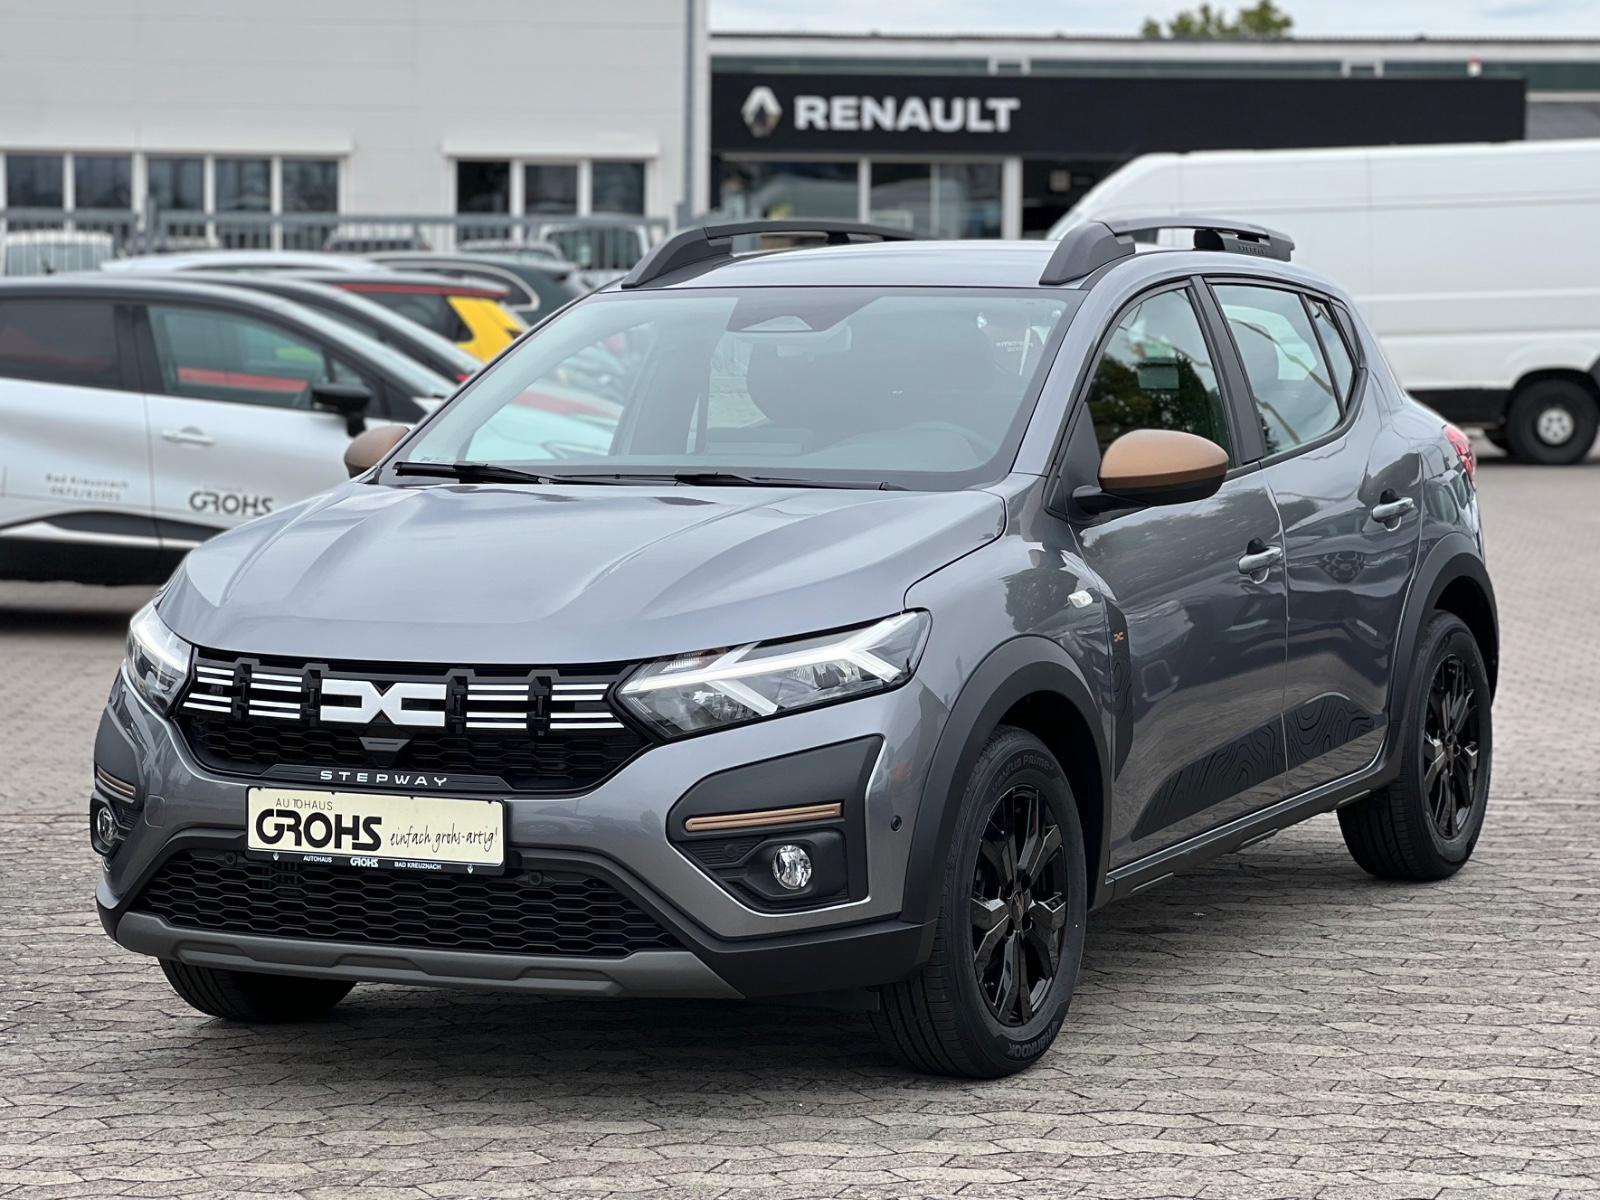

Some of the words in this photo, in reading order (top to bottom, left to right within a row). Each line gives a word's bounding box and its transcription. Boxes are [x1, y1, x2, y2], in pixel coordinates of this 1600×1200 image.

[794, 95, 1020, 132] RENAULT
[189, 490, 273, 517] GROHS
[320, 770, 447, 787] STEPWAY
[275, 798, 333, 811] AUTOHAUS
[255, 808, 382, 852] GROHS
[390, 824, 431, 848] einfach
[303, 855, 333, 863] AUTOHAUS
[350, 857, 379, 868] GROHS
[394, 861, 407, 869] BAD
[407, 862, 442, 870] KREUZNACH
